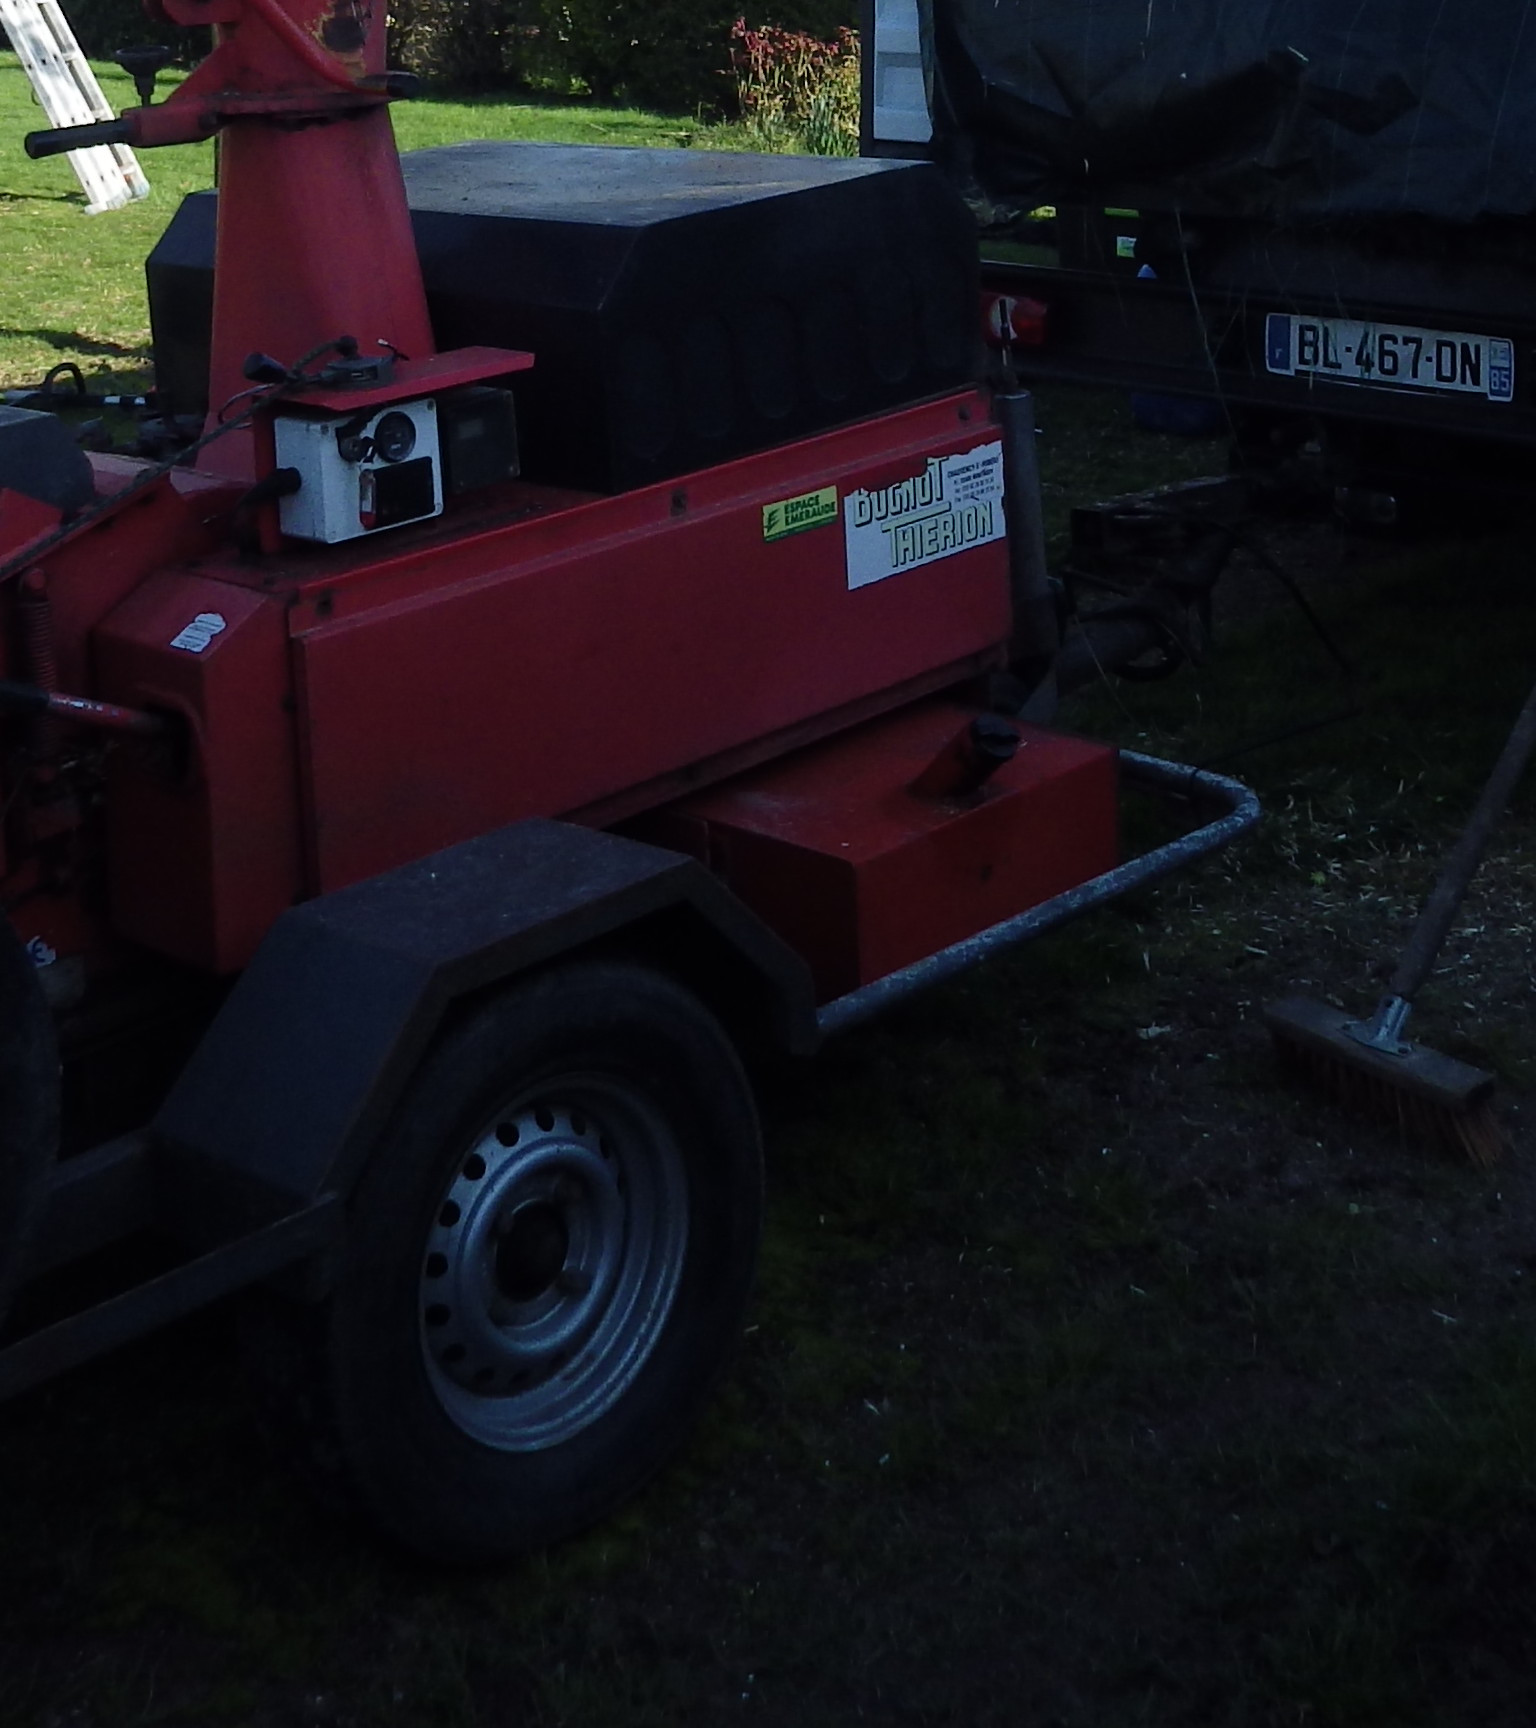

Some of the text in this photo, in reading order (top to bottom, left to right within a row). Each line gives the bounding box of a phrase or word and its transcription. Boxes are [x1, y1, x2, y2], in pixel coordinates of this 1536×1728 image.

[1298, 324, 1481, 387] BL-467-DN
[1491, 369, 1510, 391] 85
[784, 494, 820, 514] ESPACE
[881, 501, 994, 568] THIERION
